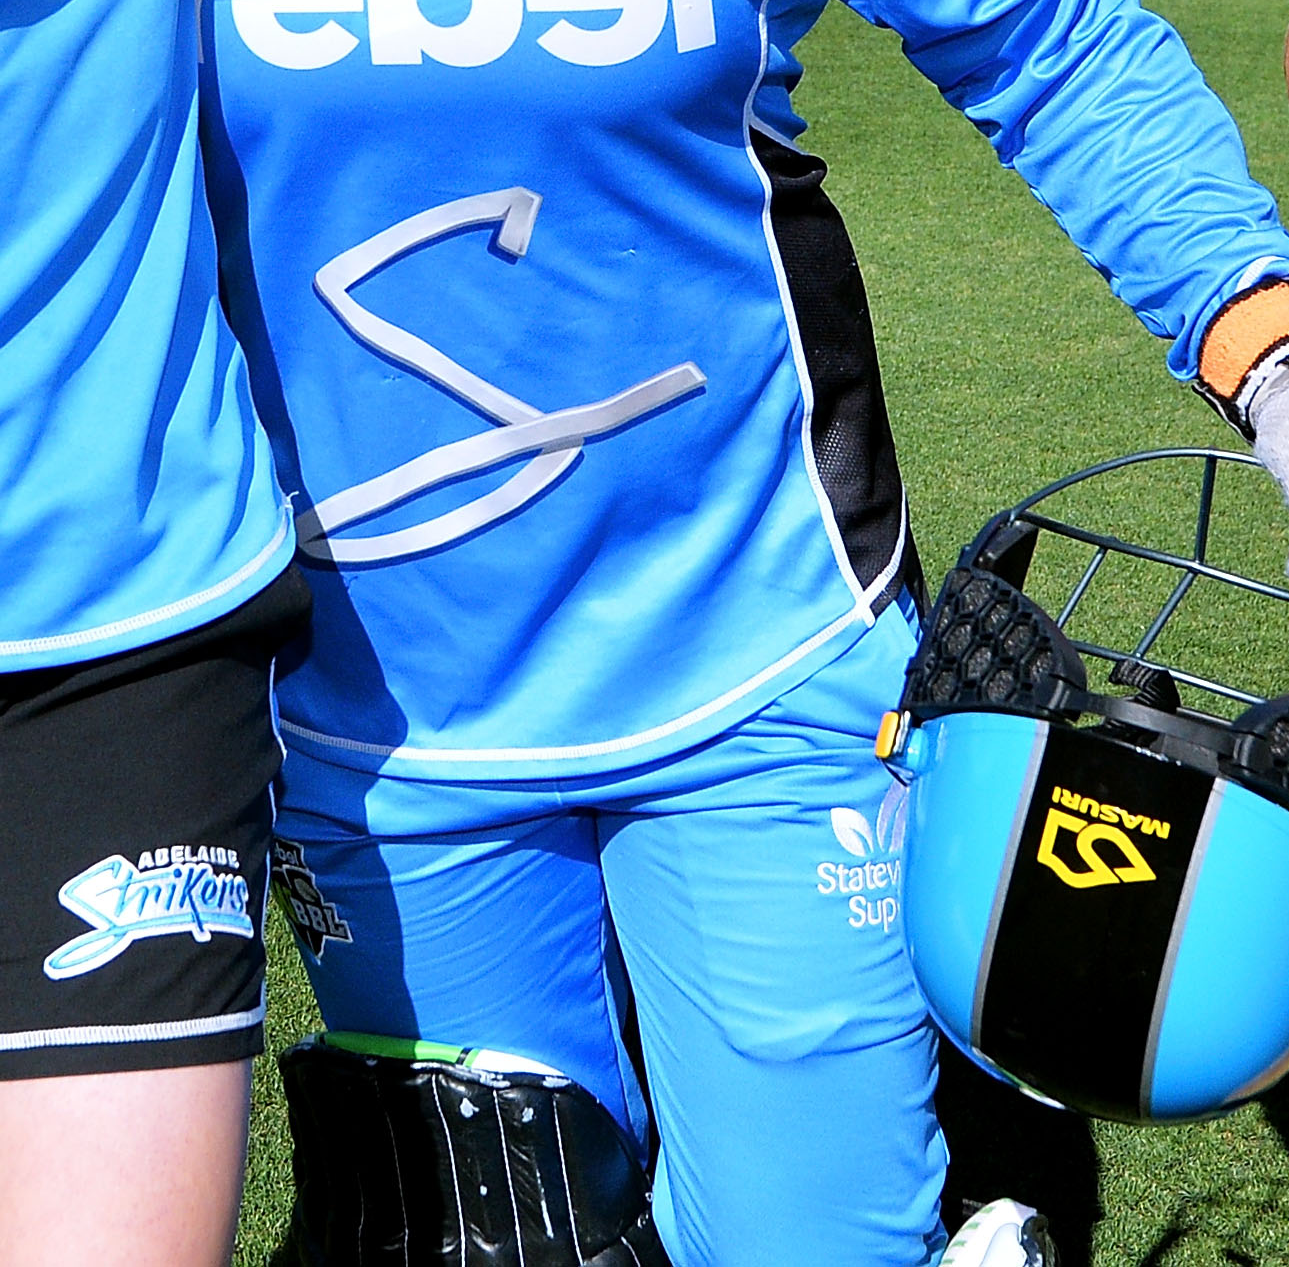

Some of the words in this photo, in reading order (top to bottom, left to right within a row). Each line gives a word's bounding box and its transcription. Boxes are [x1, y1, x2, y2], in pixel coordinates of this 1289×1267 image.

[1052, 786, 1171, 840] MASURI
[137, 844, 241, 871] ADELAIDE
[290, 896, 347, 938] BBL
[848, 895, 900, 933] Sup
